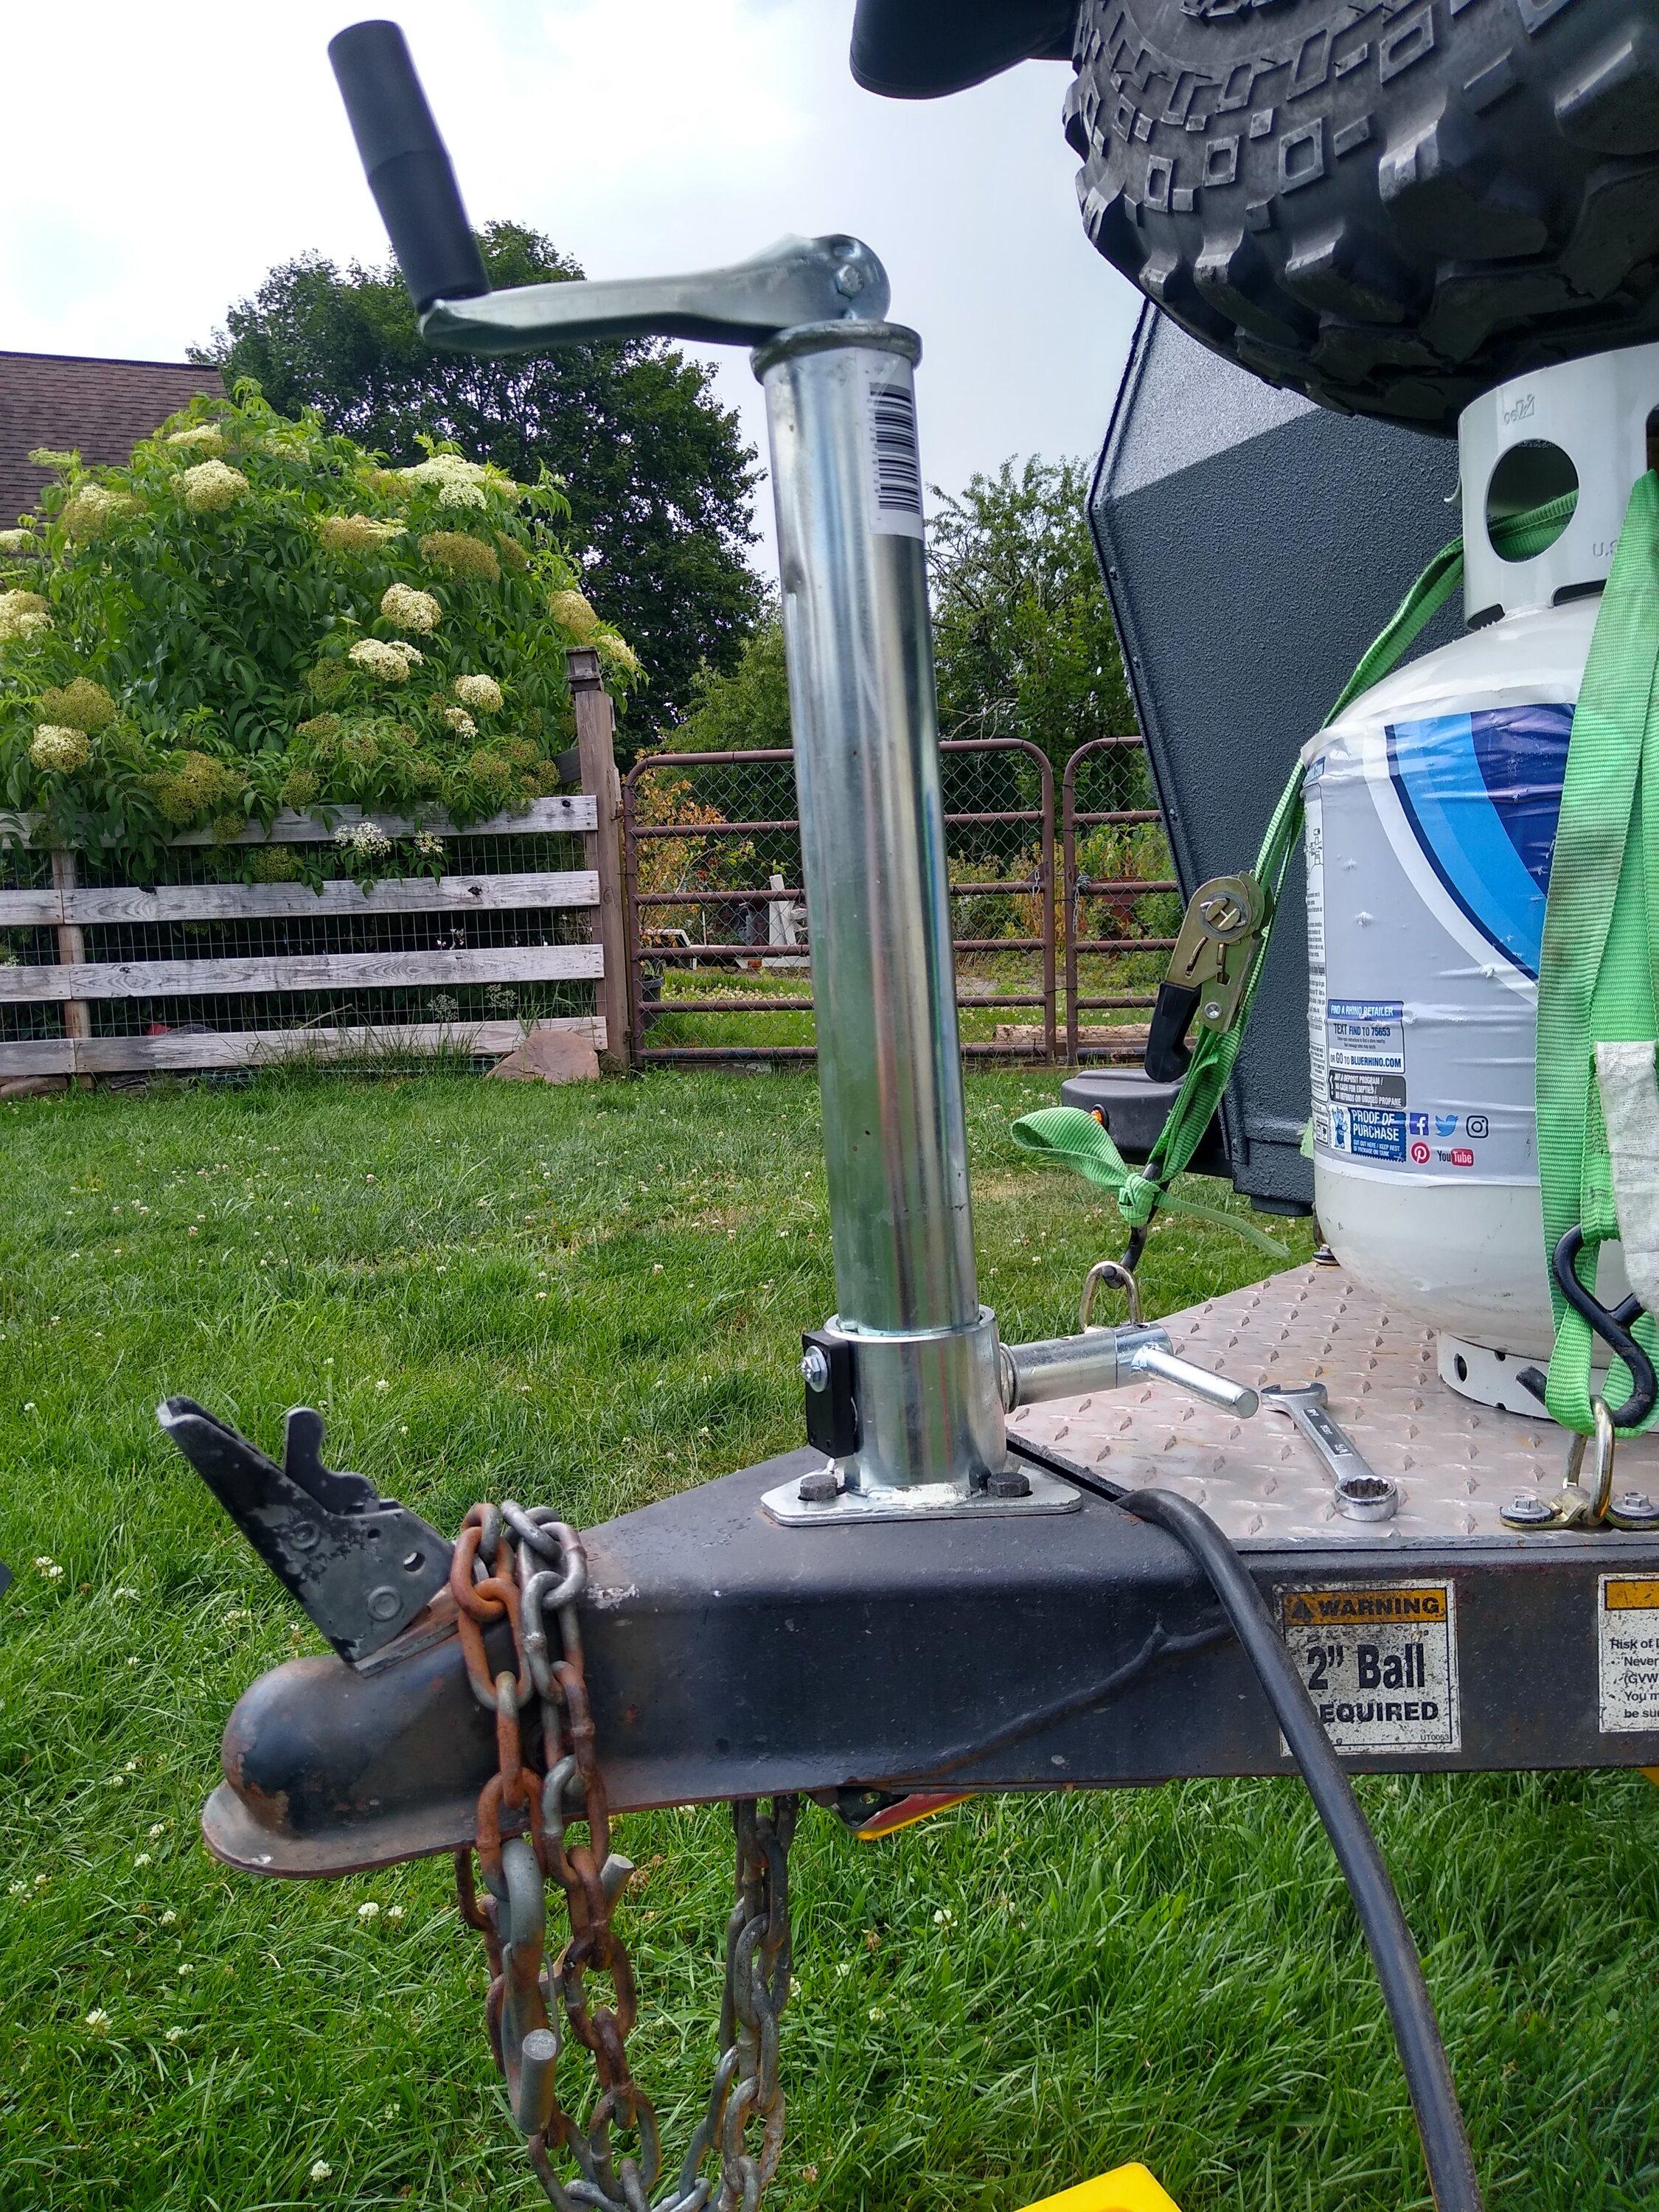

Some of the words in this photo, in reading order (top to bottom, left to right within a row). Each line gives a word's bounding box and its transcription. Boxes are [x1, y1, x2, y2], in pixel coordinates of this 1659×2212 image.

[1331, 1005, 1340, 1015] FIND
[1341, 1006, 1345, 1015] A
[1346, 1006, 1362, 1016] RHINO
[1363, 1006, 1394, 1016] RETAILER
[1333, 1023, 1347, 1034] TEXT
[1349, 1026, 1361, 1035] FIND
[1362, 1026, 1370, 1036] TO
[1371, 1027, 1391, 1037] 75653
[1330, 1054, 1335, 1062] OR
[1336, 1052, 1343, 1064] GO
[1344, 1056, 1350, 1065] TO
[1351, 1056, 1401, 1068] BLUERHINO.COM
[1379, 1096, 1401, 1106] PROPANE
[1351, 1110, 1380, 1124] PROOF
[1382, 1113, 1394, 1126] OF
[1353, 1124, 1399, 1141] PURCHASE
[1437, 1150, 1472, 1164] YouTube
[1318, 1596, 1439, 1616] WARNING
[1610, 1638, 1638, 1650] Risk
[1641, 1638, 1652, 1649] of
[1357, 1643, 1425, 1690] Ball
[1624, 1656, 1659, 1666] Never
[1624, 1691, 1646, 1703] You
[1319, 1701, 1439, 1723] EQUIRED
[1624, 1708, 1639, 1718] be
[1420, 1734, 1450, 1742] UT0053
